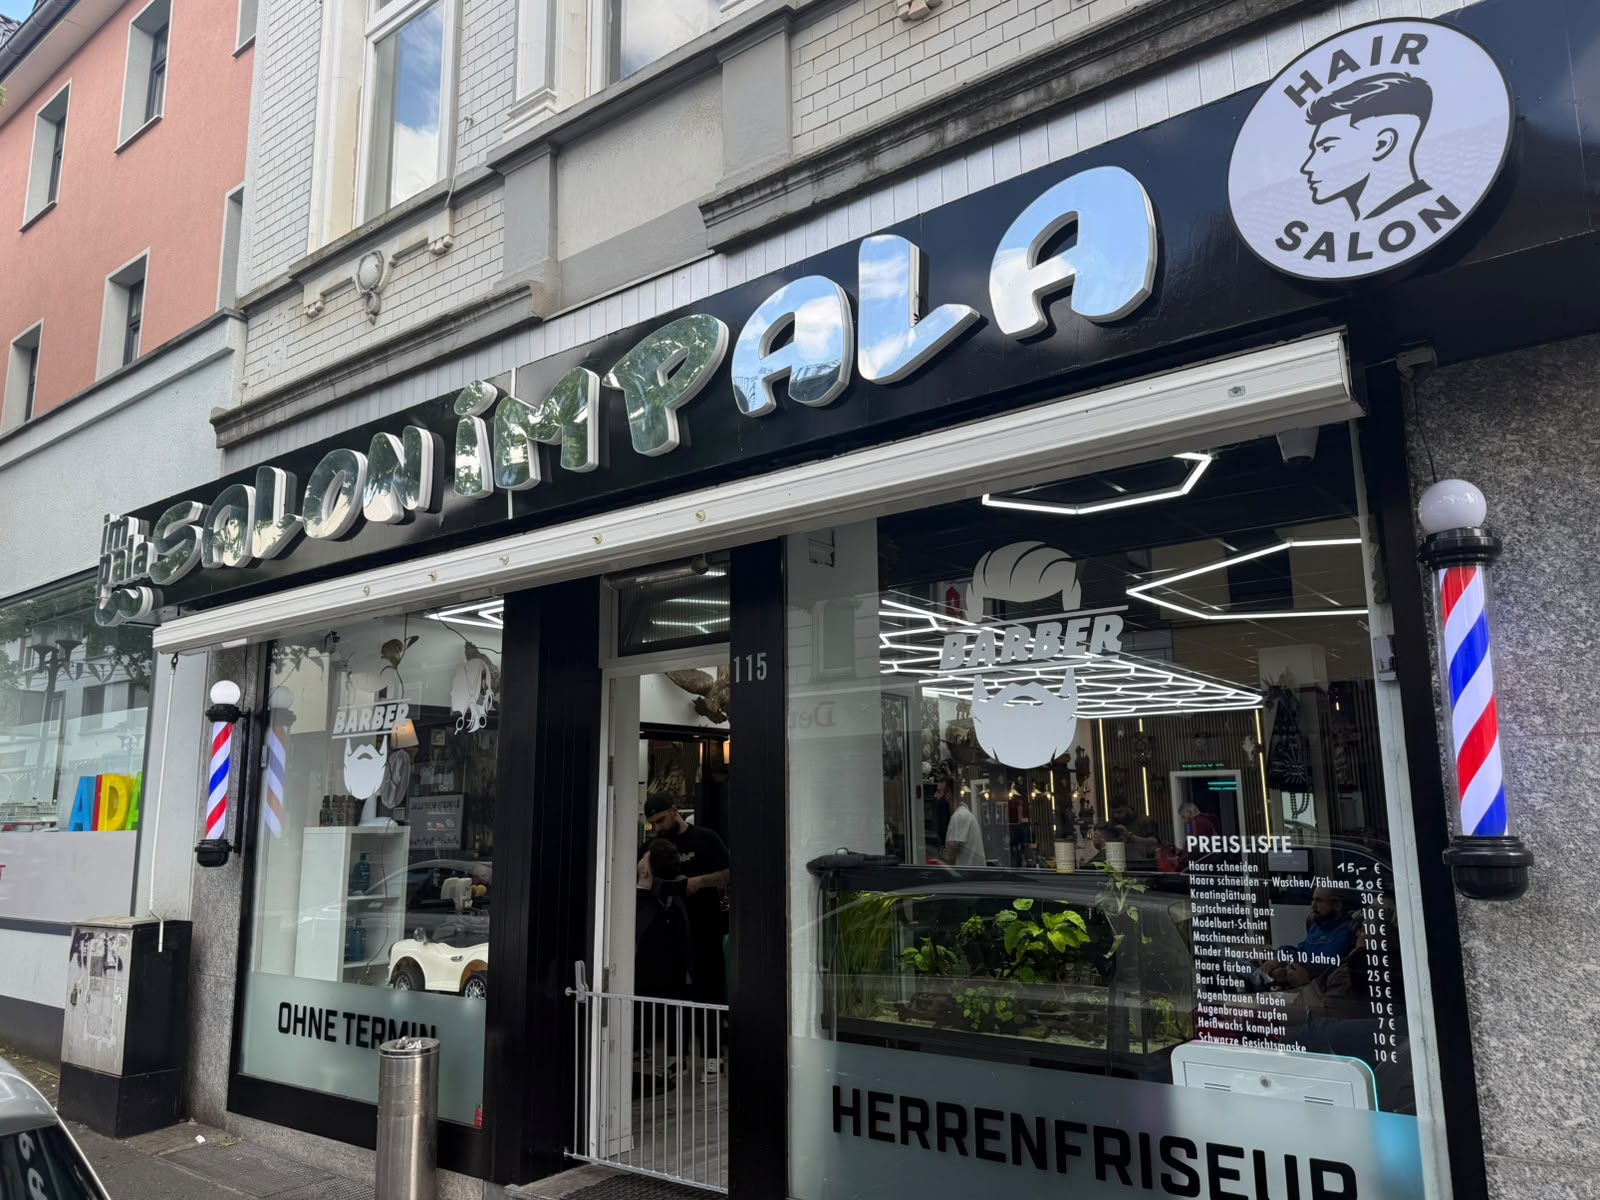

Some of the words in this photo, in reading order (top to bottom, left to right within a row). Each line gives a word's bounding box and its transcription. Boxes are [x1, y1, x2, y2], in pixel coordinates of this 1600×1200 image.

[1283, 33, 1428, 109] HAIR
[1275, 195, 1462, 263] SALON
[939, 614, 1124, 670] BARBER
[733, 652, 768, 683] 115
[332, 703, 410, 735] BARBER
[1186, 835, 1293, 854] PREISLISTE
[1188, 860, 1214, 871] Haare
[1216, 860, 1259, 872] schneiden
[1374, 862, 1381, 874] €
[1189, 874, 1214, 885] Haare
[1217, 874, 1260, 887] schneiden
[1272, 875, 1350, 889] Waschen/Föhnen
[1356, 879, 1374, 890] 20
[1376, 878, 1383, 889] €
[1190, 889, 1257, 903] Kreatinglättung
[1361, 893, 1374, 904] 30
[1377, 893, 1384, 904] €
[1191, 902, 1250, 915] Bartschneiden
[1253, 908, 1275, 918] ganz
[1362, 908, 1374, 920] 10
[1378, 908, 1385, 920] €
[1192, 916, 1267, 930] Modelbart-Schnitt
[1363, 923, 1376, 935] 10
[1379, 924, 1386, 936] €
[1193, 930, 1265, 945] Maschinenschnitt
[1365, 939, 1377, 951] 10
[1381, 940, 1388, 951] €
[1194, 944, 1221, 957] Kinder
[1224, 947, 1274, 961] Haarschnitt
[1277, 949, 1294, 963] (bis
[1297, 951, 1308, 963] 10
[1310, 951, 1341, 967] Jahre)
[1366, 954, 1379, 966] 10
[1382, 955, 1389, 967] €
[1195, 959, 1220, 971] Haare
[1223, 960, 1252, 974] färben
[1367, 970, 1380, 982] 25
[1384, 970, 1390, 982] €
[1196, 973, 1214, 985] Bart
[1216, 974, 1245, 988] färben
[1369, 985, 1381, 998] 15
[1385, 986, 1392, 998] €
[1197, 989, 1253, 1004] Augenbrauen
[1256, 992, 1286, 1007] färben
[1370, 1001, 1383, 1014] 10
[1386, 1003, 1393, 1015] €
[278, 1001, 338, 1043] OHNE
[1197, 1003, 1254, 1018] Augenbrauen
[1257, 1008, 1288, 1022] zupfen
[1378, 1017, 1384, 1029] 7
[1388, 1018, 1395, 1030] €
[1198, 1017, 1243, 1032] Heißwachs
[1246, 1021, 1286, 1037] komplett
[1373, 1032, 1386, 1045] 10
[1389, 1034, 1396, 1046] €
[1198, 1032, 1239, 1046] Schwarze
[1242, 1036, 1307, 1053] Gesichtsmaske
[1374, 1049, 1387, 1062] 10
[1391, 1051, 1398, 1063] €
